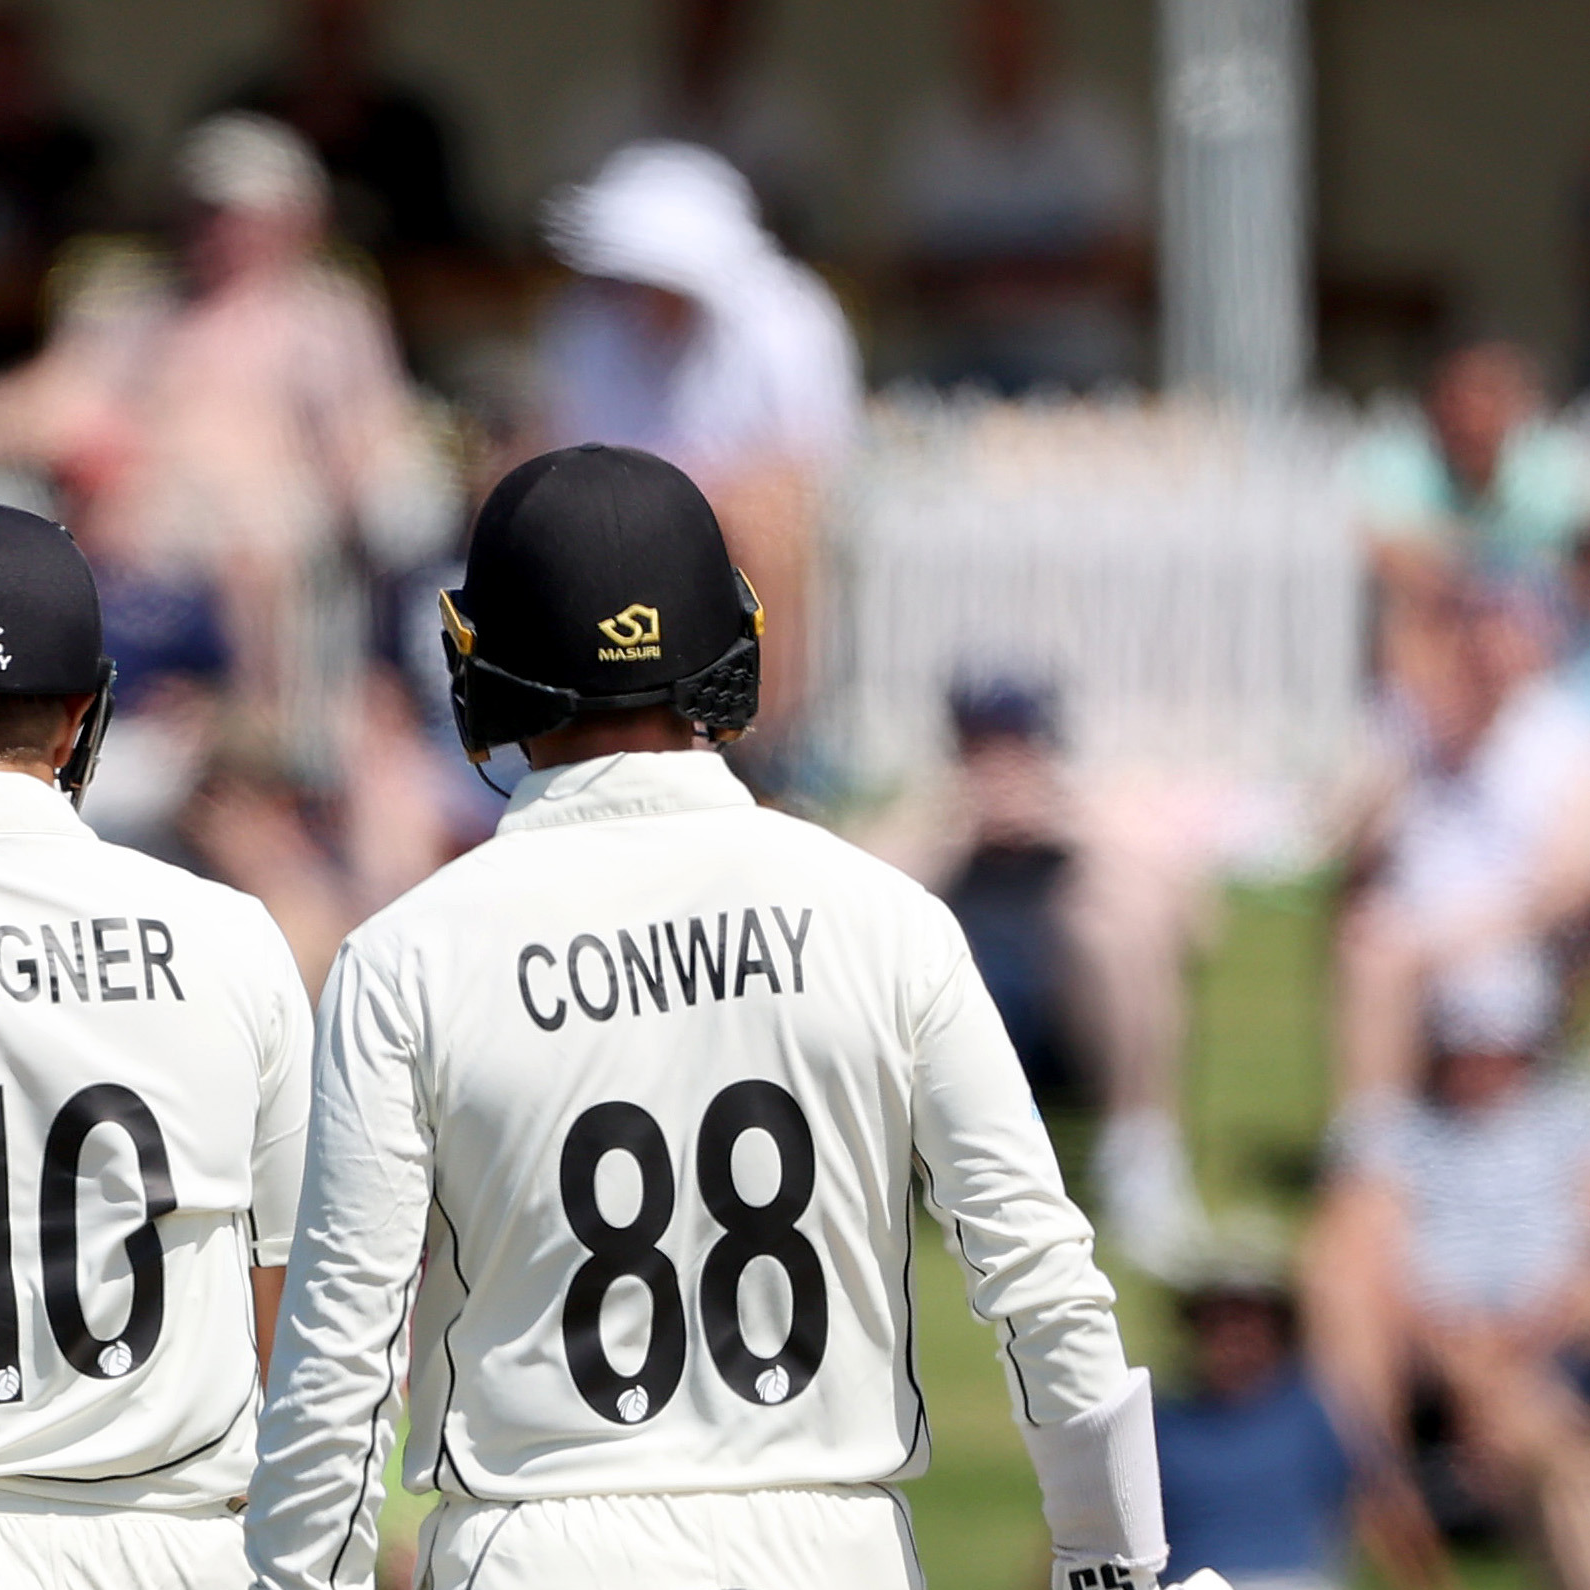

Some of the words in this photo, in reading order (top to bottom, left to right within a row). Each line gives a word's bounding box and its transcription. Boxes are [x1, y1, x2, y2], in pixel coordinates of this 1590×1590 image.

[598, 645, 661, 662] MASURI
[517, 905, 813, 1032] CONWAY
[559, 1079, 829, 1426] 88
